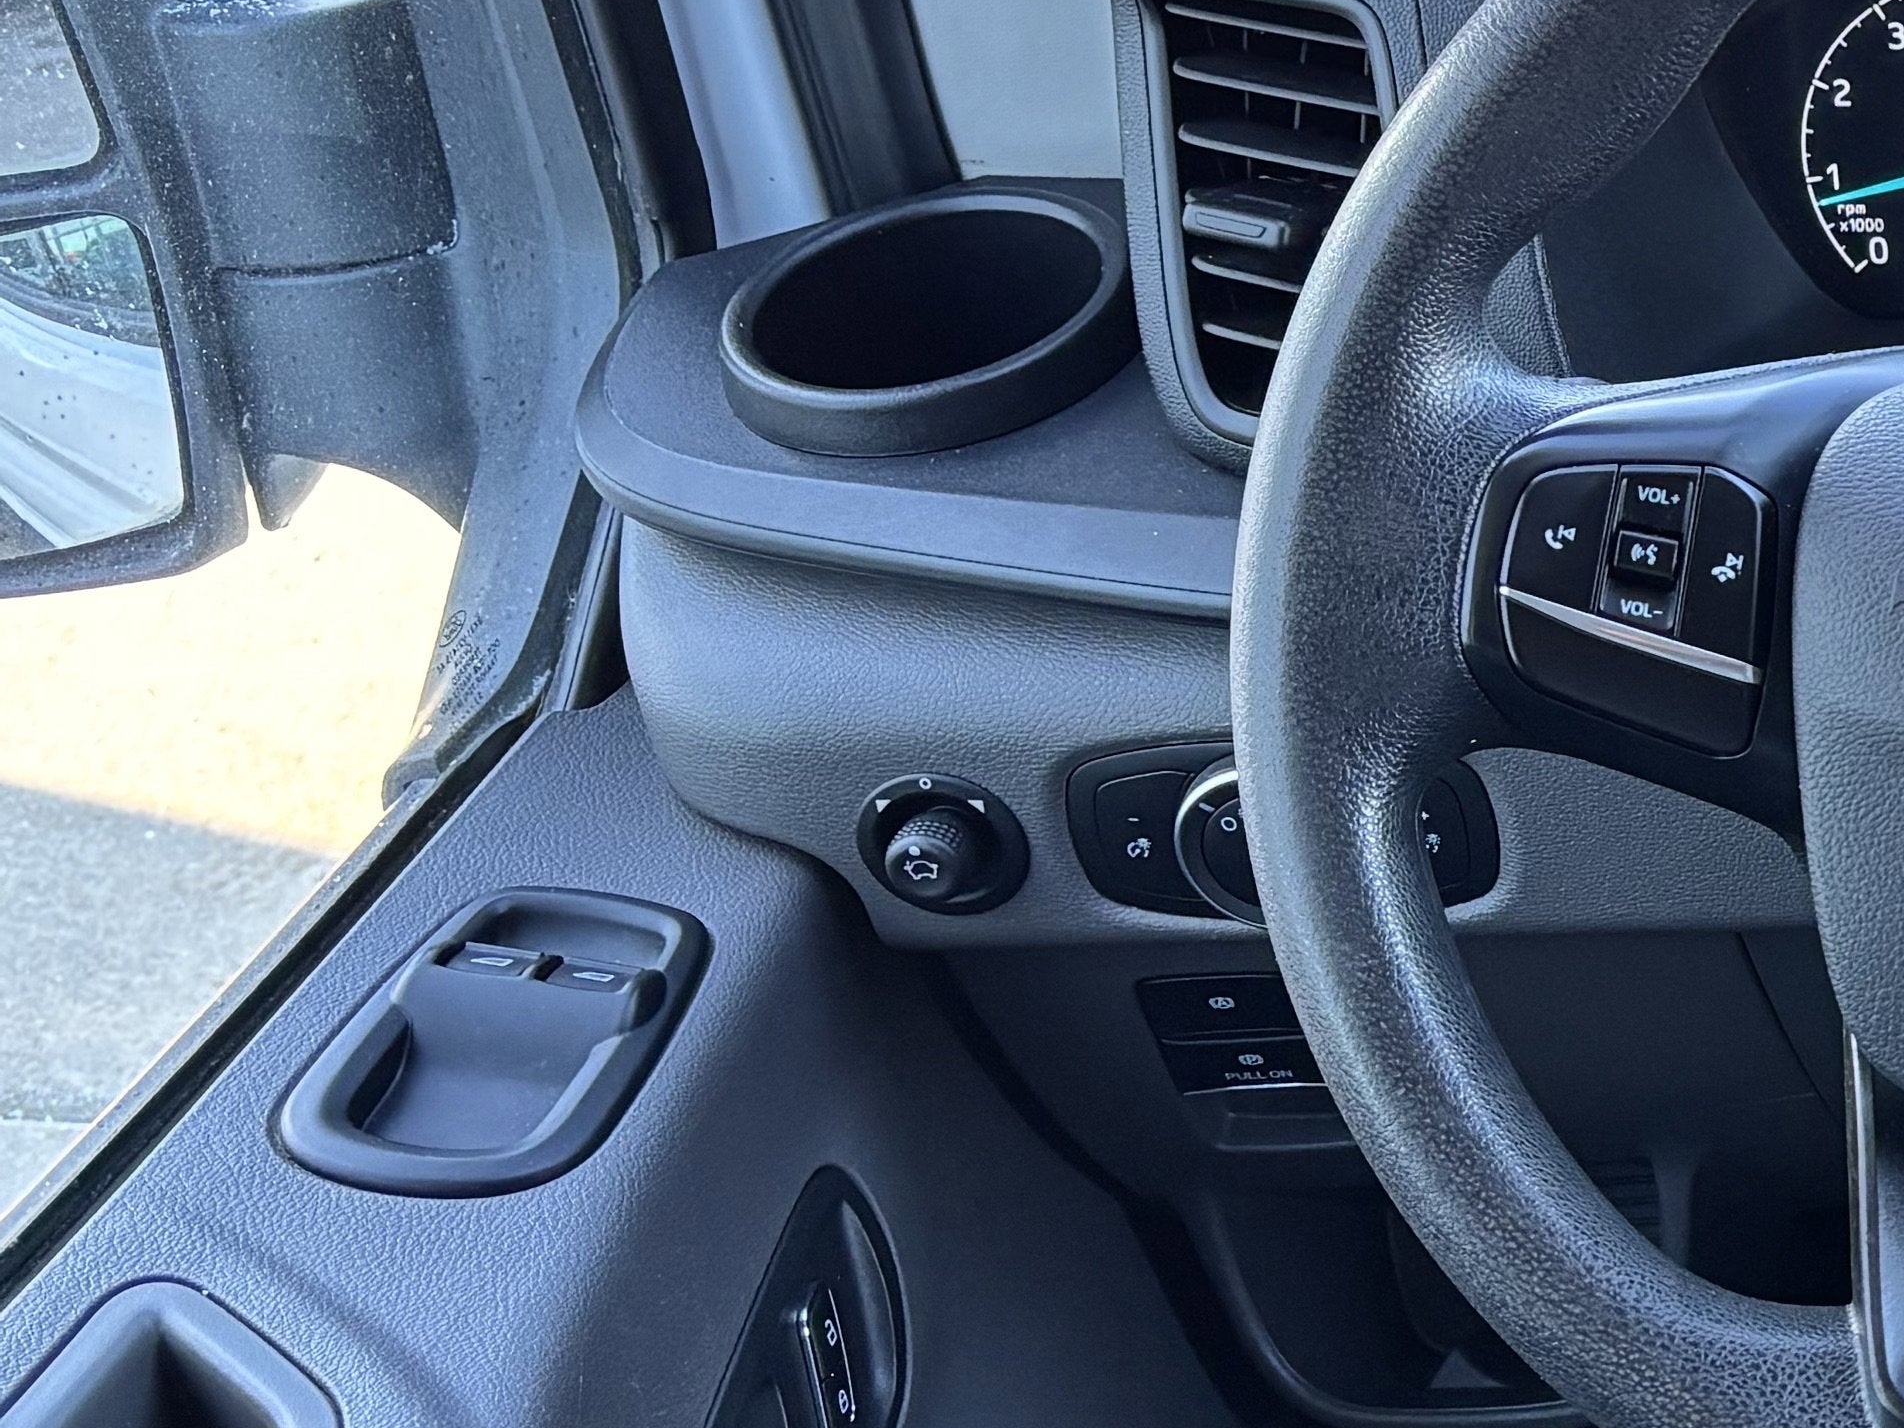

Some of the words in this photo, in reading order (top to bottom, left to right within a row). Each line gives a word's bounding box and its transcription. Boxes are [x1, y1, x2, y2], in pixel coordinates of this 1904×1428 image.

[1832, 78, 1852, 107] 2
[1825, 162, 1840, 191] 1
[1836, 202, 1867, 217] rpm
[1839, 217, 1885, 233] x1000
[1868, 236, 1889, 265] 0
[1637, 484, 1682, 506] VOL+
[1224, 1070, 1268, 1081] PULL
[1269, 1069, 1294, 1079] ON
